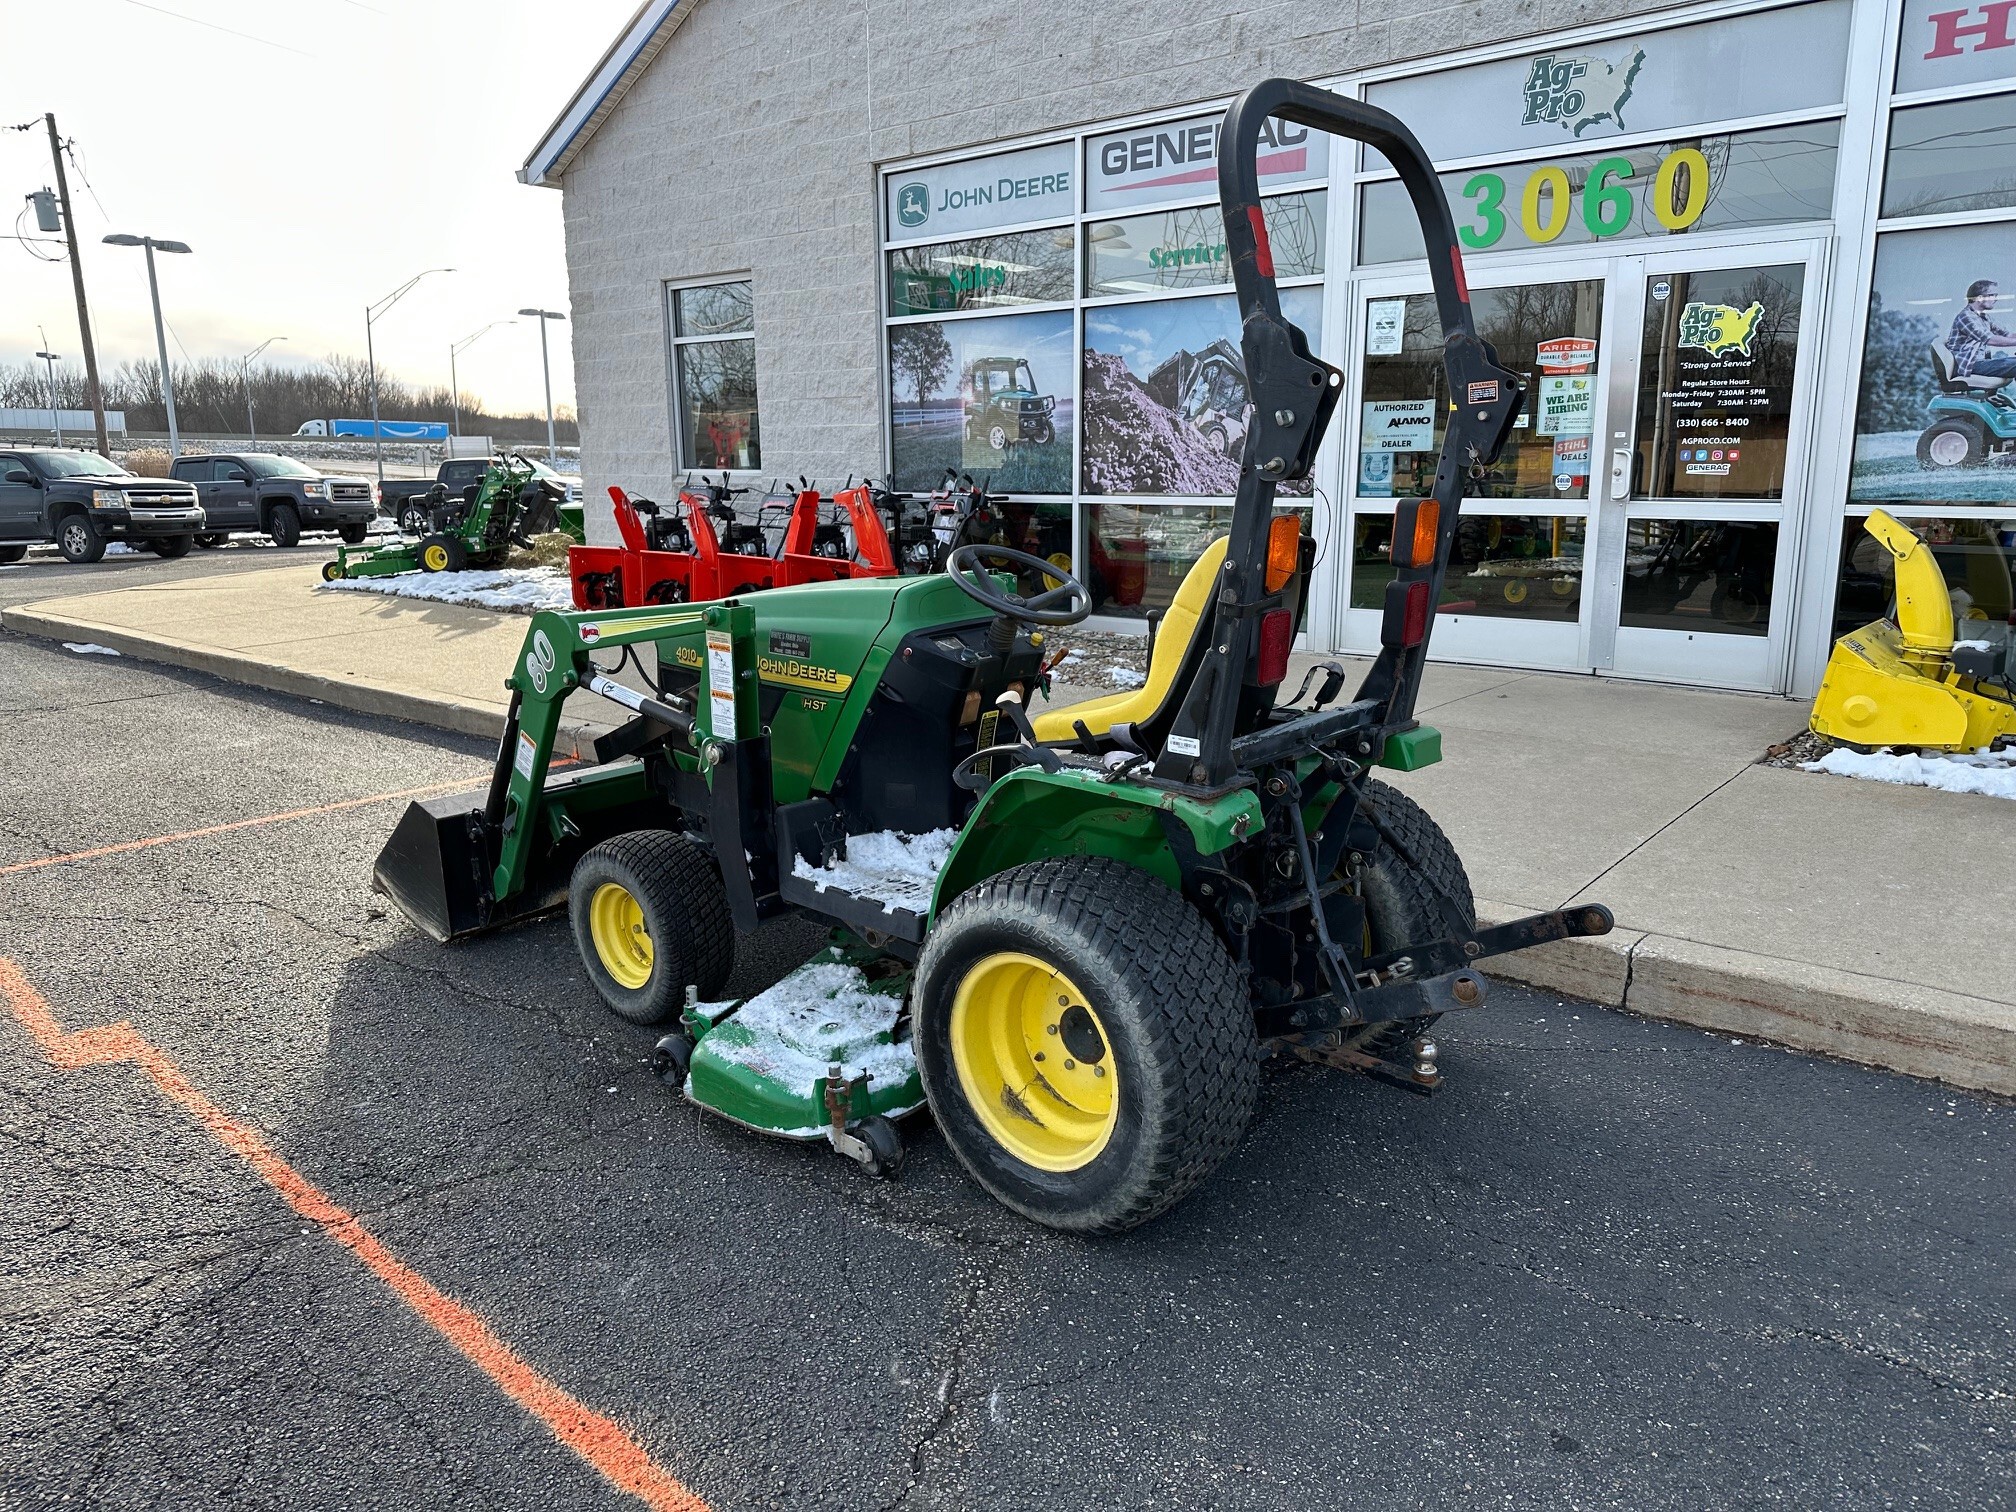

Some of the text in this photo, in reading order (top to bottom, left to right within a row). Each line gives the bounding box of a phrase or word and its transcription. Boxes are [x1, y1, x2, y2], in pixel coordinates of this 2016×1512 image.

[1524, 55, 1588, 95] Ag-
[1522, 89, 1585, 125] Pro
[937, 172, 1070, 212] JOHN DEERE
[1458, 148, 1710, 248] 3060
[1148, 242, 1227, 269] Service
[949, 263, 1005, 293] Sales
[1683, 304, 1725, 328] Ag-
[1680, 325, 1723, 344] Pro
[1542, 343, 1590, 352] ARIENS
[1682, 380, 1708, 388] Regular
[1545, 392, 1590, 405] WE ARE
[1661, 390, 1715, 399] Monday-Friday
[1749, 388, 1766, 396] 5PM
[1373, 403, 1424, 412] AUTHORIZED
[1547, 402, 1588, 414] HIRING
[1672, 400, 1702, 408] Saturday
[1387, 416, 1431, 428] ALAMO
[1676, 418, 1700, 428] (330)
[1701, 418, 1719, 427] 666
[1725, 418, 1750, 426] 8400
[1381, 440, 1412, 448] DEALER
[1556, 439, 1588, 452] STIHL
[1681, 437, 1741, 445] AGPROCO.COM
[1561, 452, 1588, 461] DEALS
[526, 629, 555, 694] 80
[676, 647, 697, 663] 4010
[788, 660, 838, 684] DEERE
[803, 698, 827, 711] HST
[993, 917, 1078, 962] MULTI
